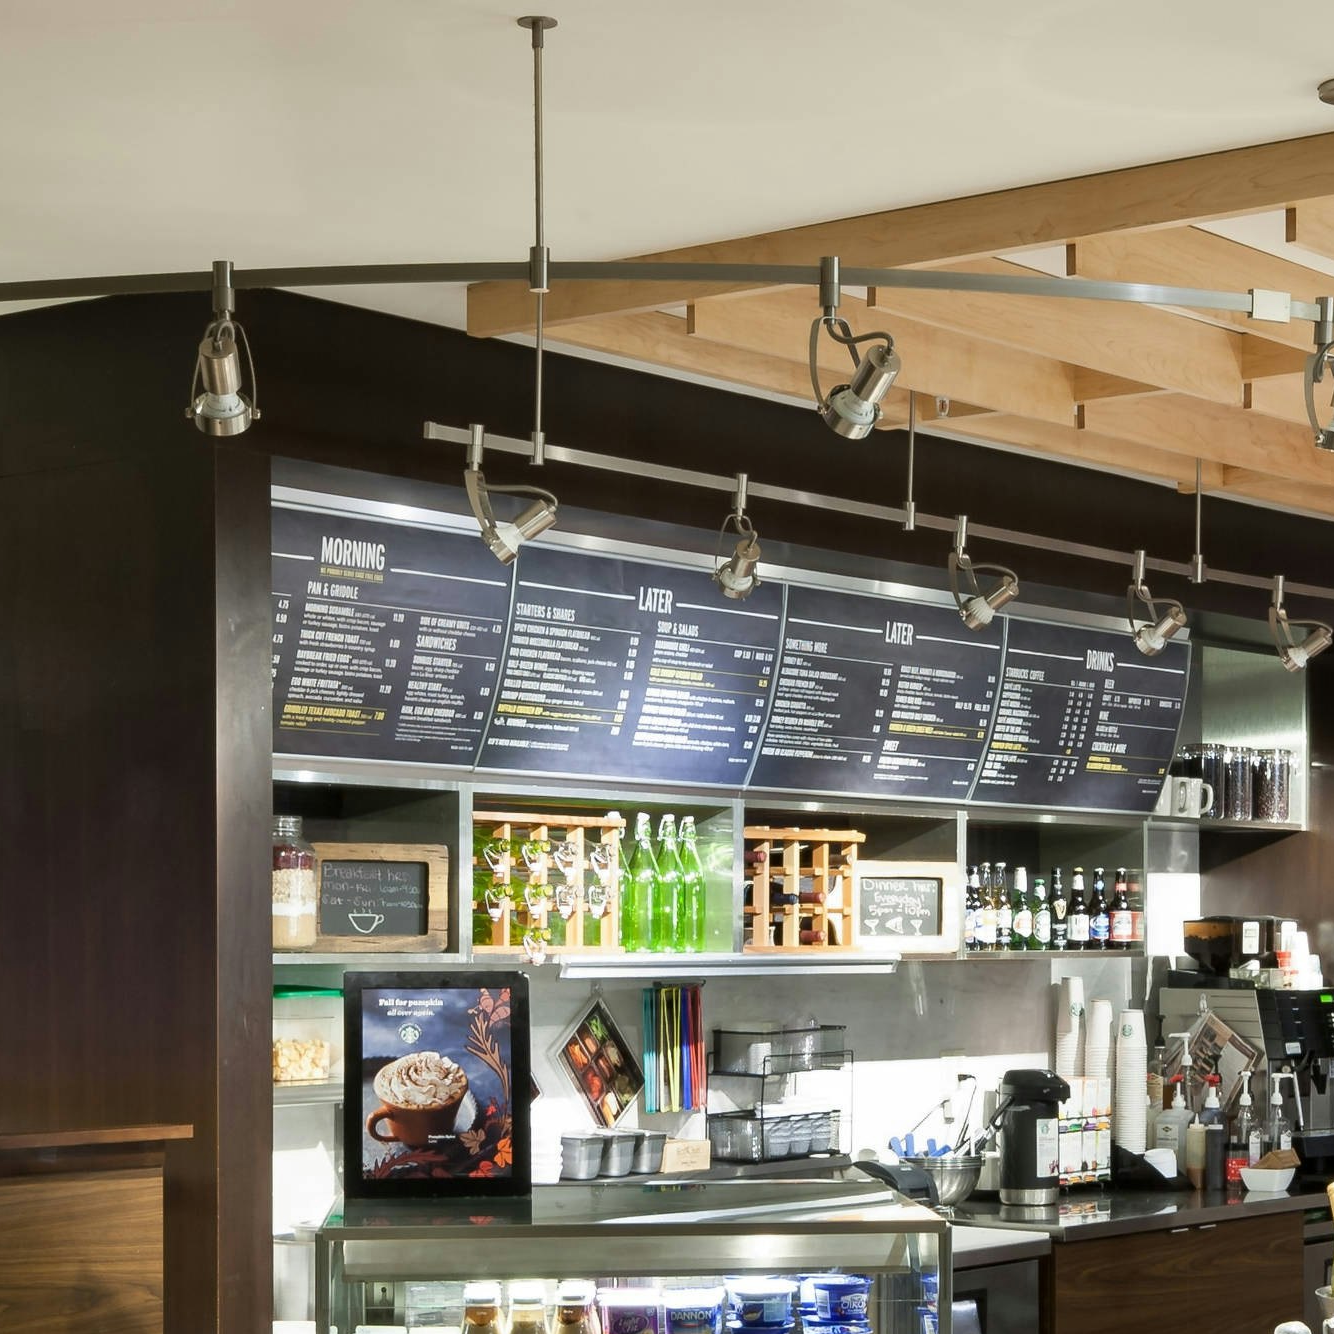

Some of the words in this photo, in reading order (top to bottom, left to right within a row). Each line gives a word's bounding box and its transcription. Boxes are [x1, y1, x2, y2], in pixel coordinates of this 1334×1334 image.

[321, 536, 385, 570] MORNING
[308, 581, 322, 595] PAN
[323, 582, 329, 596] &
[330, 584, 359, 599] GRIDDLE
[639, 586, 673, 614] LATER
[516, 603, 546, 618] STARTERS
[547, 606, 551, 619] &
[552, 607, 576, 622] SHARES
[657, 620, 673, 634] SOUP
[673, 622, 677, 635] &
[678, 623, 699, 637] SALADS
[885, 620, 914, 646] LATER
[416, 634, 457, 651] SANDWICHES
[1087, 649, 1115, 672] DRINKS
[1005, 666, 1029, 680] STARBUCKS
[1029, 670, 1045, 681] COFFEE
[863, 879, 909, 892] Dinner
[379, 998, 395, 1006] Fall
[395, 998, 407, 1006] for
[408, 998, 443, 1007] pumpkin
[671, 1310, 713, 1320] DANNON
